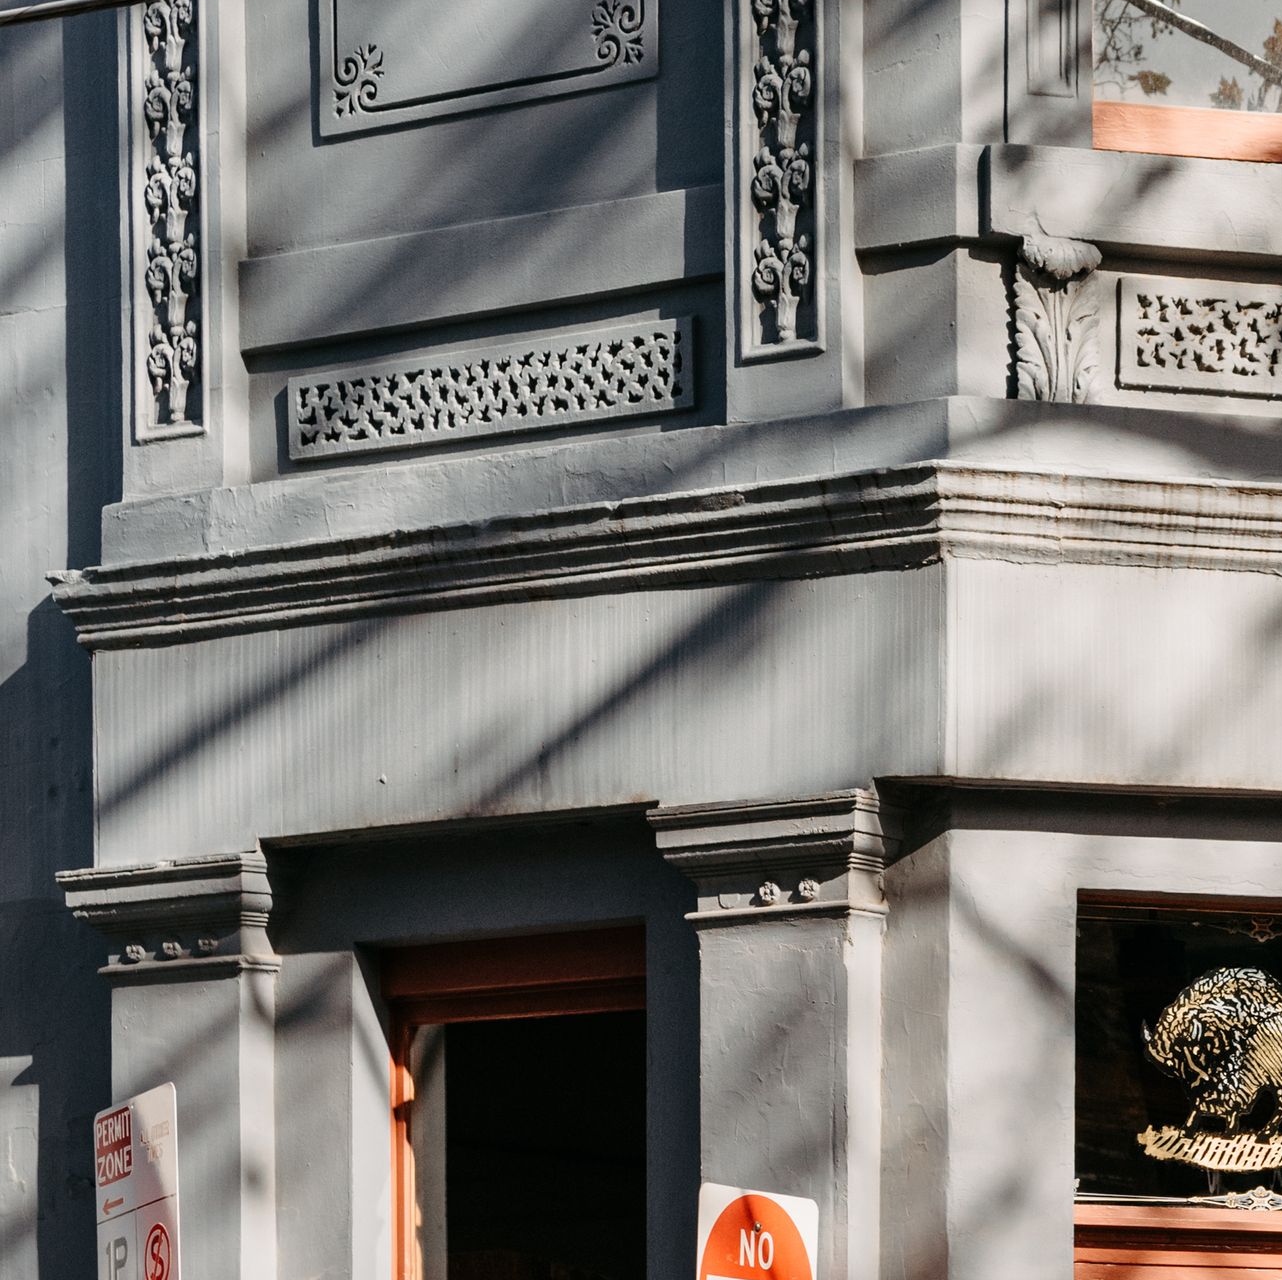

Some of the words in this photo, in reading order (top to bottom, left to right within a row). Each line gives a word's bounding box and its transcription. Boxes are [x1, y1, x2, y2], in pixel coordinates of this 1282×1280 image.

[96, 1110, 130, 1149] PERMIT
[97, 1145, 132, 1184] ZONE
[739, 1228, 774, 1271] NO
